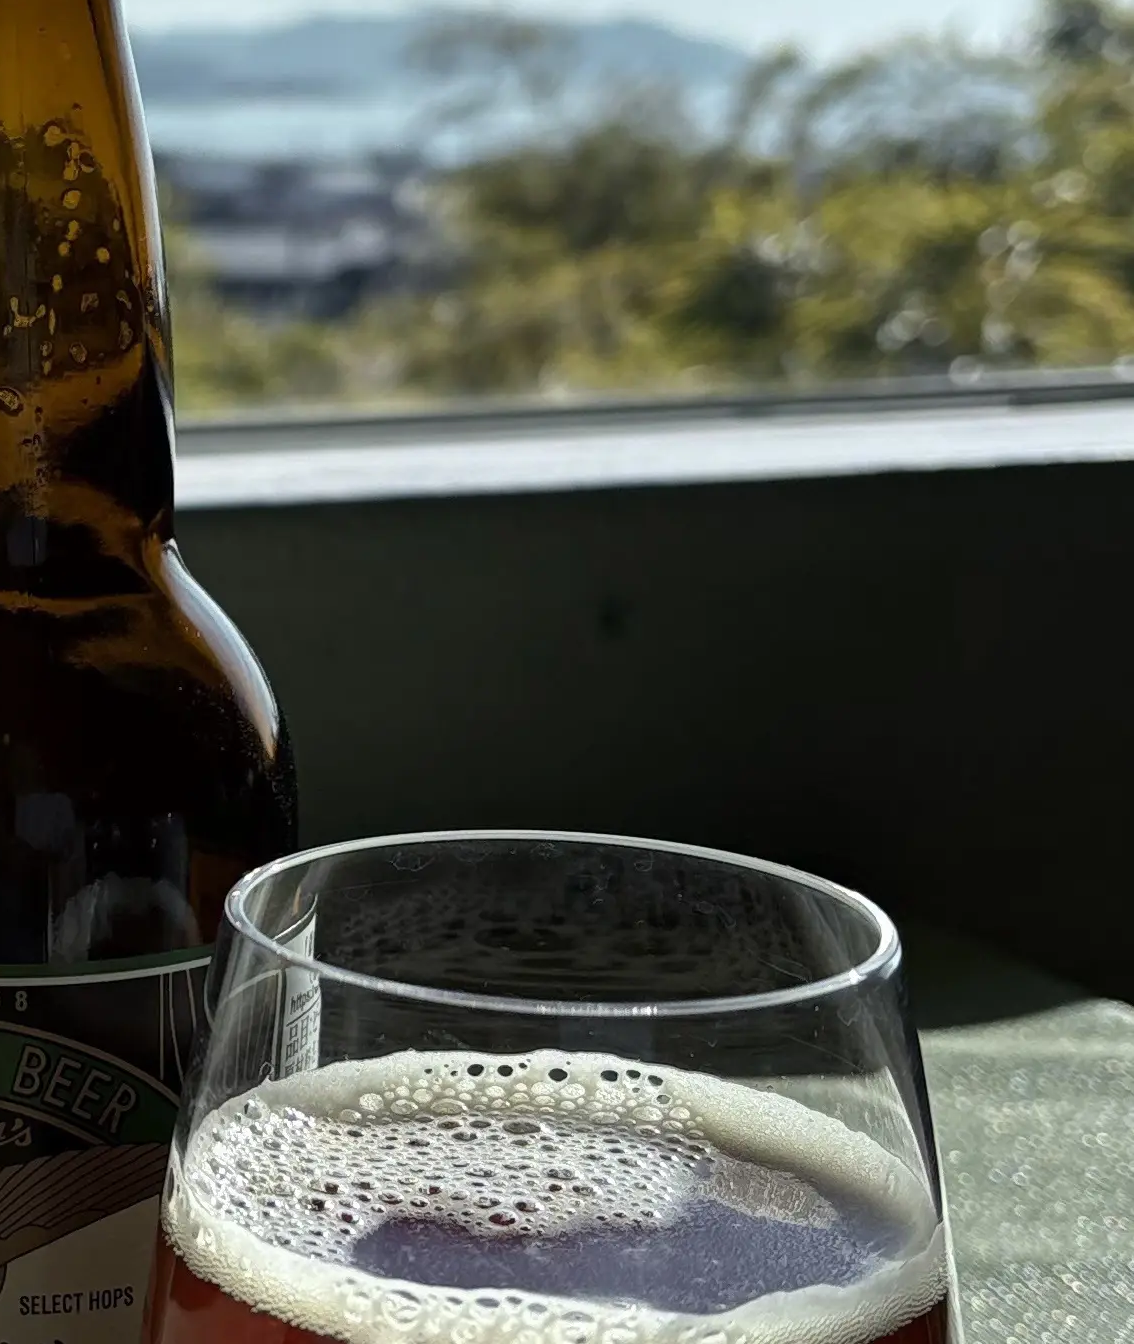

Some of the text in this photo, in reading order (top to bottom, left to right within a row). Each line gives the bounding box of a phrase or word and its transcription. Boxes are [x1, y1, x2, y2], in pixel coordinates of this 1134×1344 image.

[12, 1046, 138, 1135] BEER
[19, 1286, 134, 1316] SELECT HOPS
